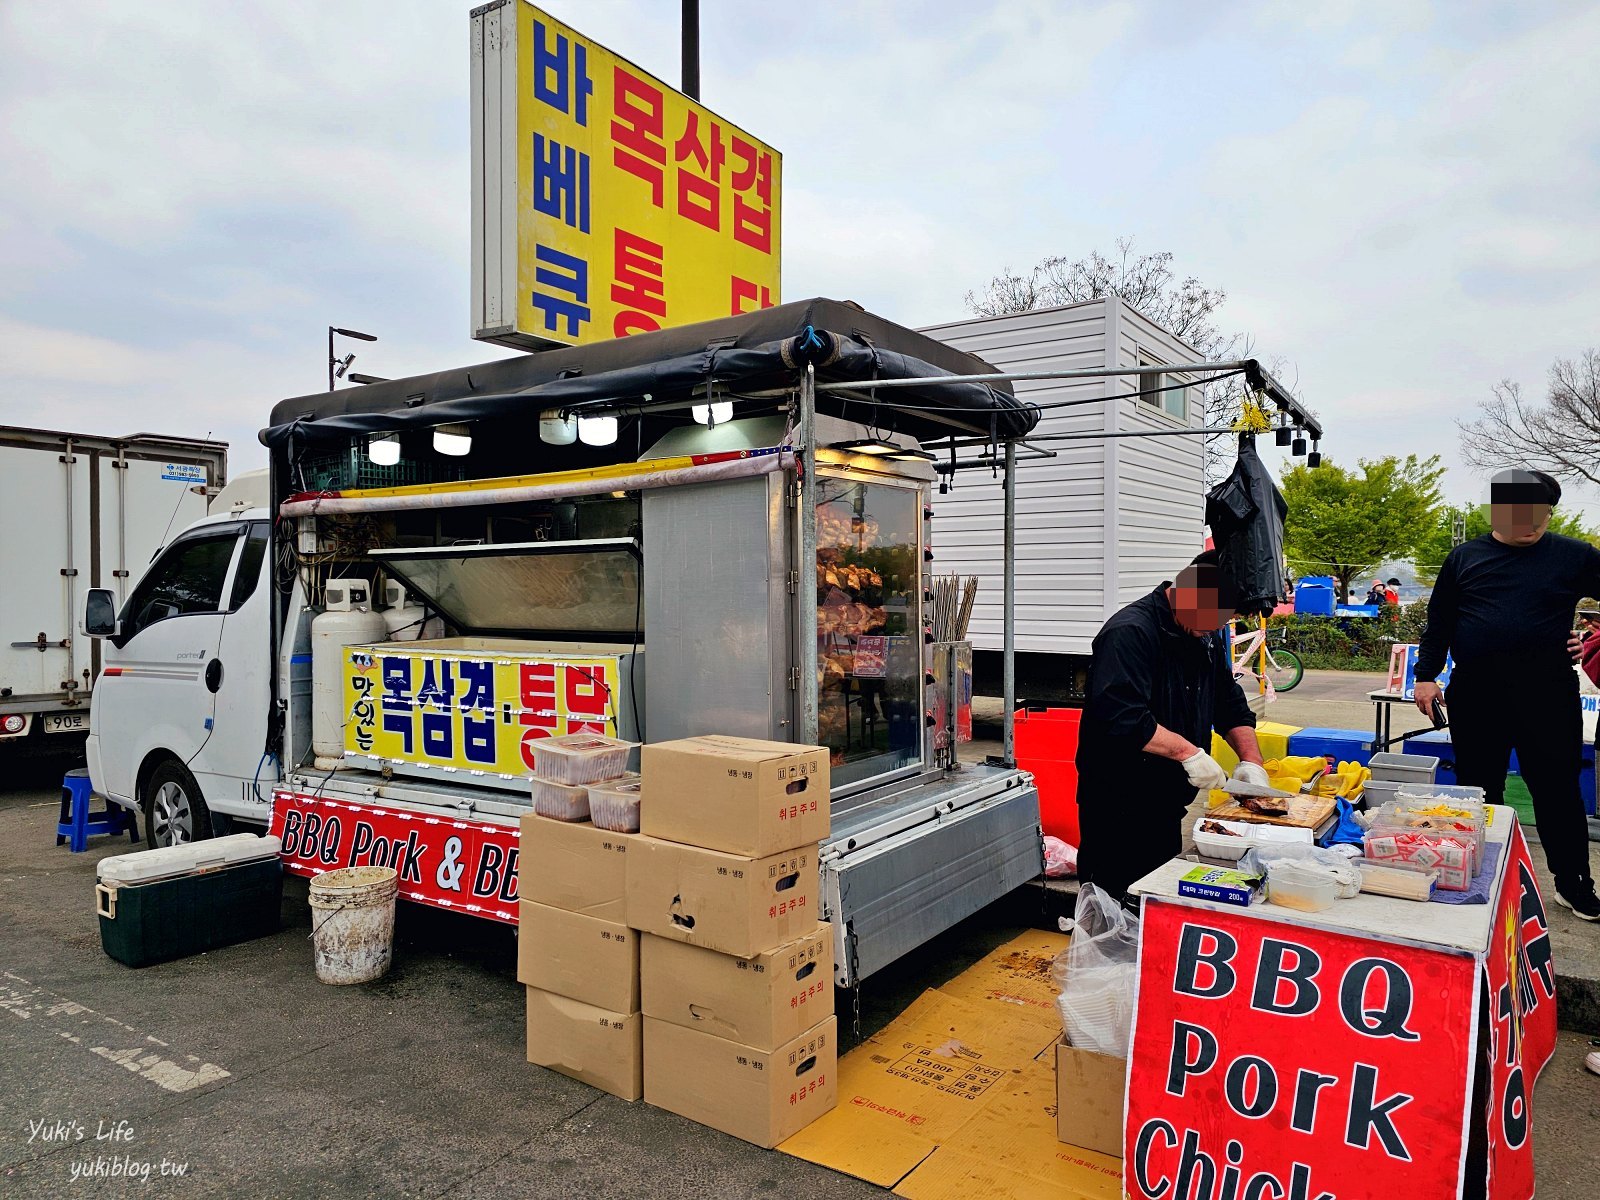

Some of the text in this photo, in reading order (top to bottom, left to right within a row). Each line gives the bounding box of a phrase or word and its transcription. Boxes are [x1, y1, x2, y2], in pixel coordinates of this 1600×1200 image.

[532, 19, 593, 337] 바베큐
[611, 65, 771, 255] 목삼겹
[54, 716, 82, 729] 90로
[352, 676, 375, 751] 맛있는
[382, 657, 496, 764] 목삼겹
[779, 800, 818, 821] 취급주의
[281, 810, 342, 864] BBQ
[350, 822, 428, 884] Pork
[436, 836, 465, 892] &
[769, 895, 806, 919] 취급주의
[790, 980, 824, 1009] 취급주의
[1173, 922, 1420, 1041] BBQ
[789, 1074, 825, 1106] 취급주의
[1166, 1020, 1413, 1162] Pork
